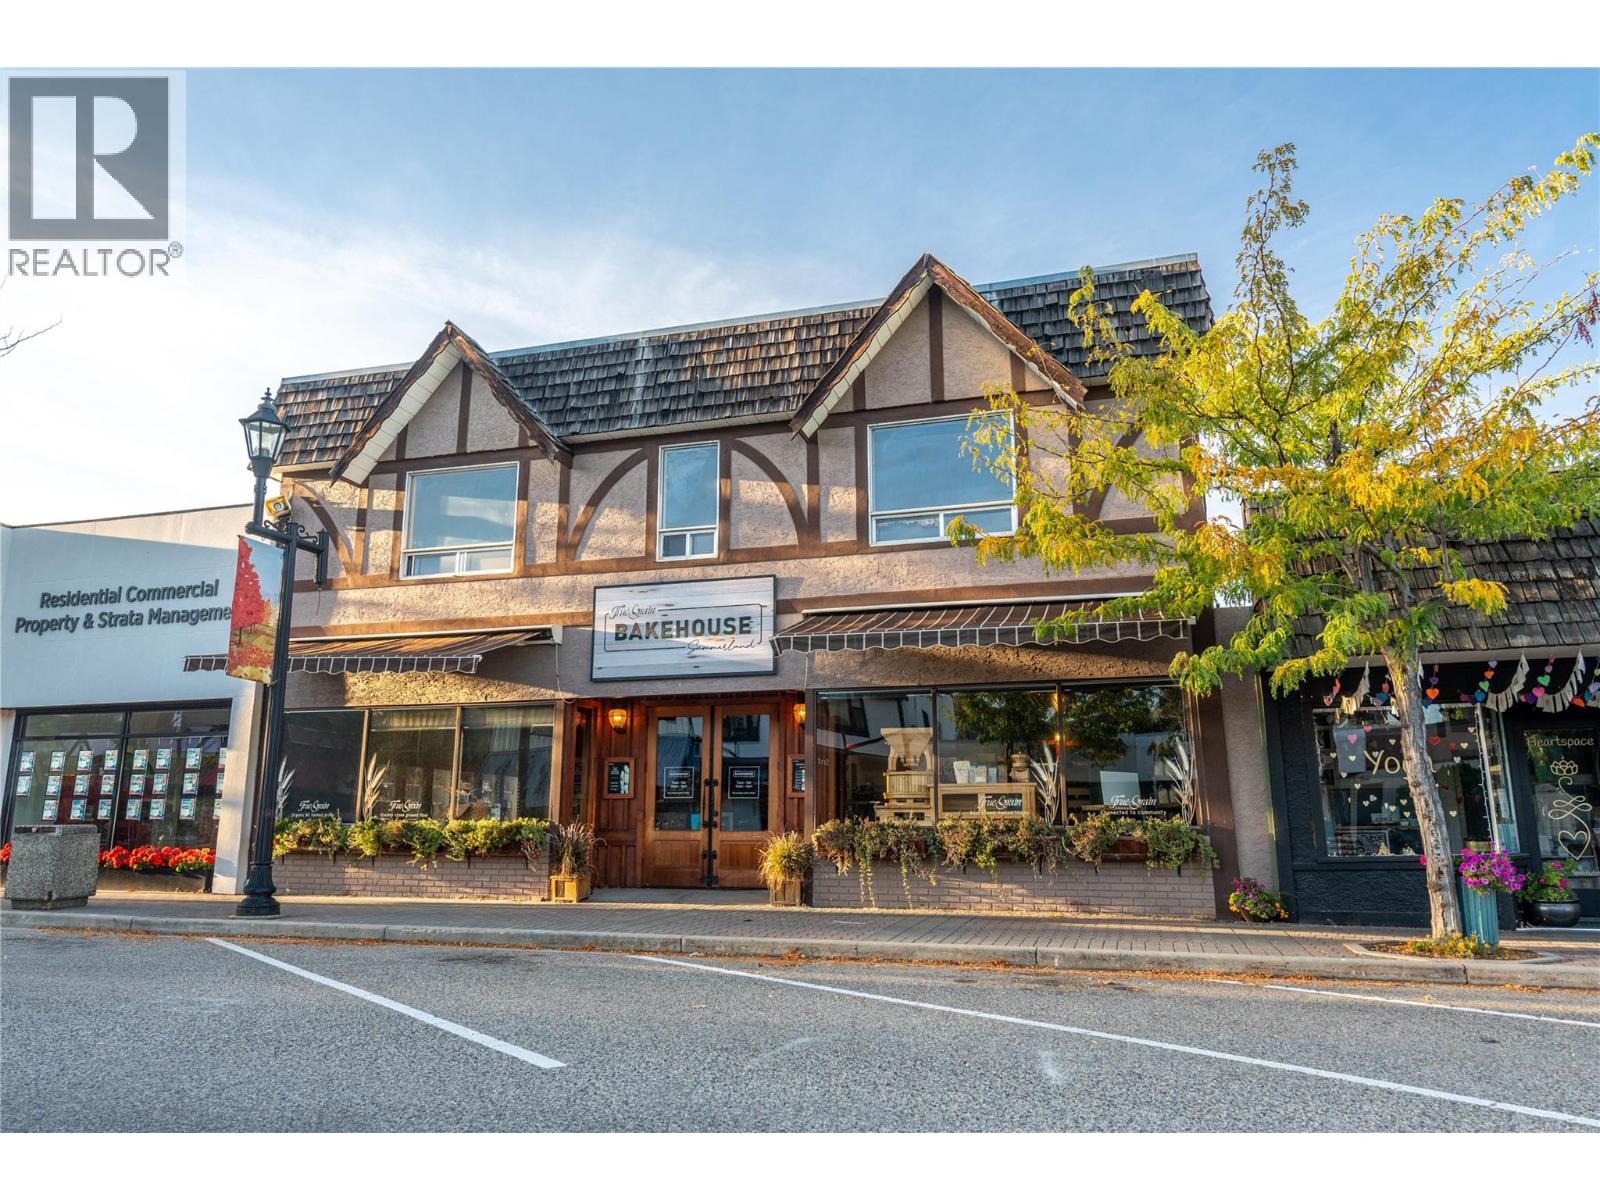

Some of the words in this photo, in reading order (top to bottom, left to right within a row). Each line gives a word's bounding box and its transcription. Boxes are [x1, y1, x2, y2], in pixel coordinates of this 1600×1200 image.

[40, 586, 122, 608] Residential
[126, 579, 219, 603] Commercial
[15, 613, 79, 636] Property
[83, 612, 94, 629] &
[97, 610, 143, 628] Strata
[148, 604, 232, 626] Manageme
[614, 616, 752, 641] BAKEHOUSE
[1526, 734, 1595, 749] Heartspace
